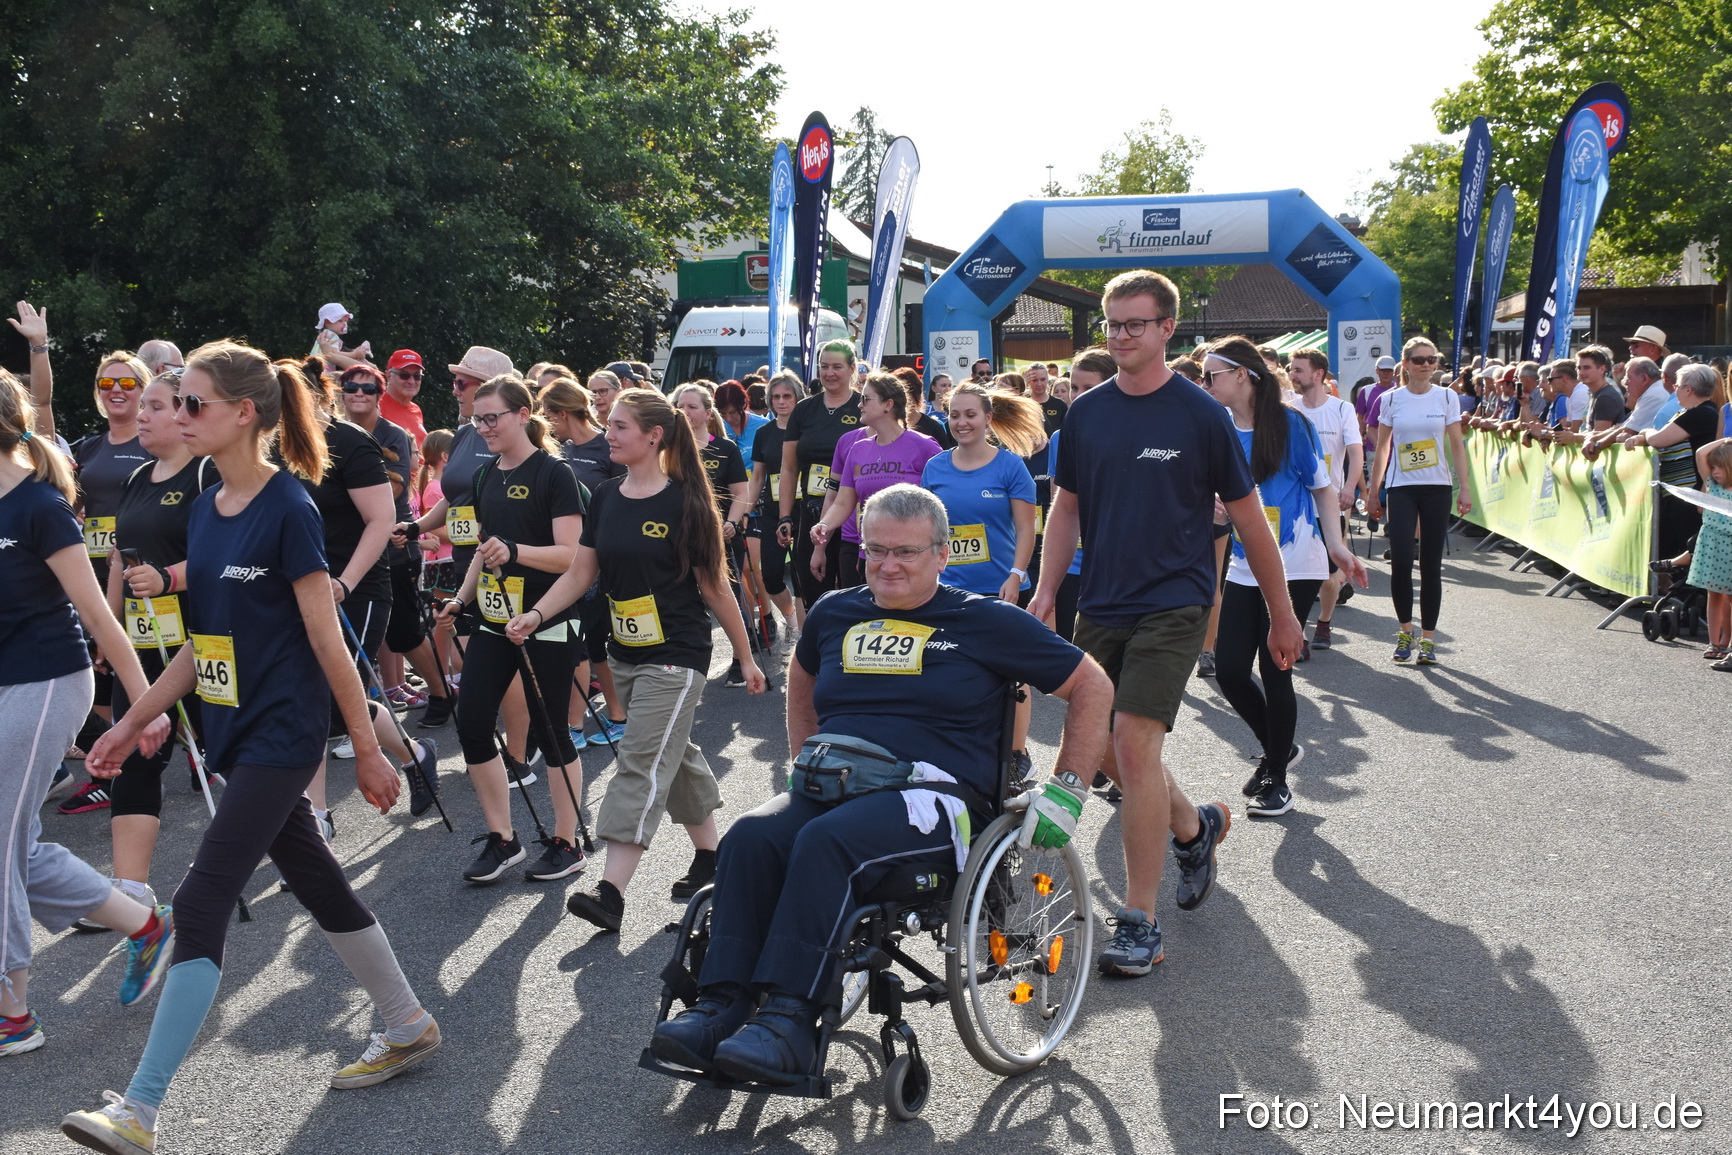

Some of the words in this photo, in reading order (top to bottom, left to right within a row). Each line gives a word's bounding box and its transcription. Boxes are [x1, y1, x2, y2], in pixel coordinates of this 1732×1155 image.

[802, 138, 829, 171] Hervis
[1150, 215, 1178, 224] Fischer
[1129, 229, 1213, 247] firmenlauf
[1314, 252, 1327, 260] das
[971, 263, 1017, 276] Fischer
[684, 328, 719, 337] abavent
[1137, 447, 1168, 460] JURA
[1411, 450, 1426, 462] 35
[860, 462, 906, 476] GRADL
[451, 520, 471, 535] 153
[220, 565, 251, 580] JURA
[485, 591, 502, 609] 55
[616, 616, 639, 634] 76
[855, 635, 914, 656] 1429
[853, 655, 885, 663] Obermeier
[886, 655, 910, 663] Richard
